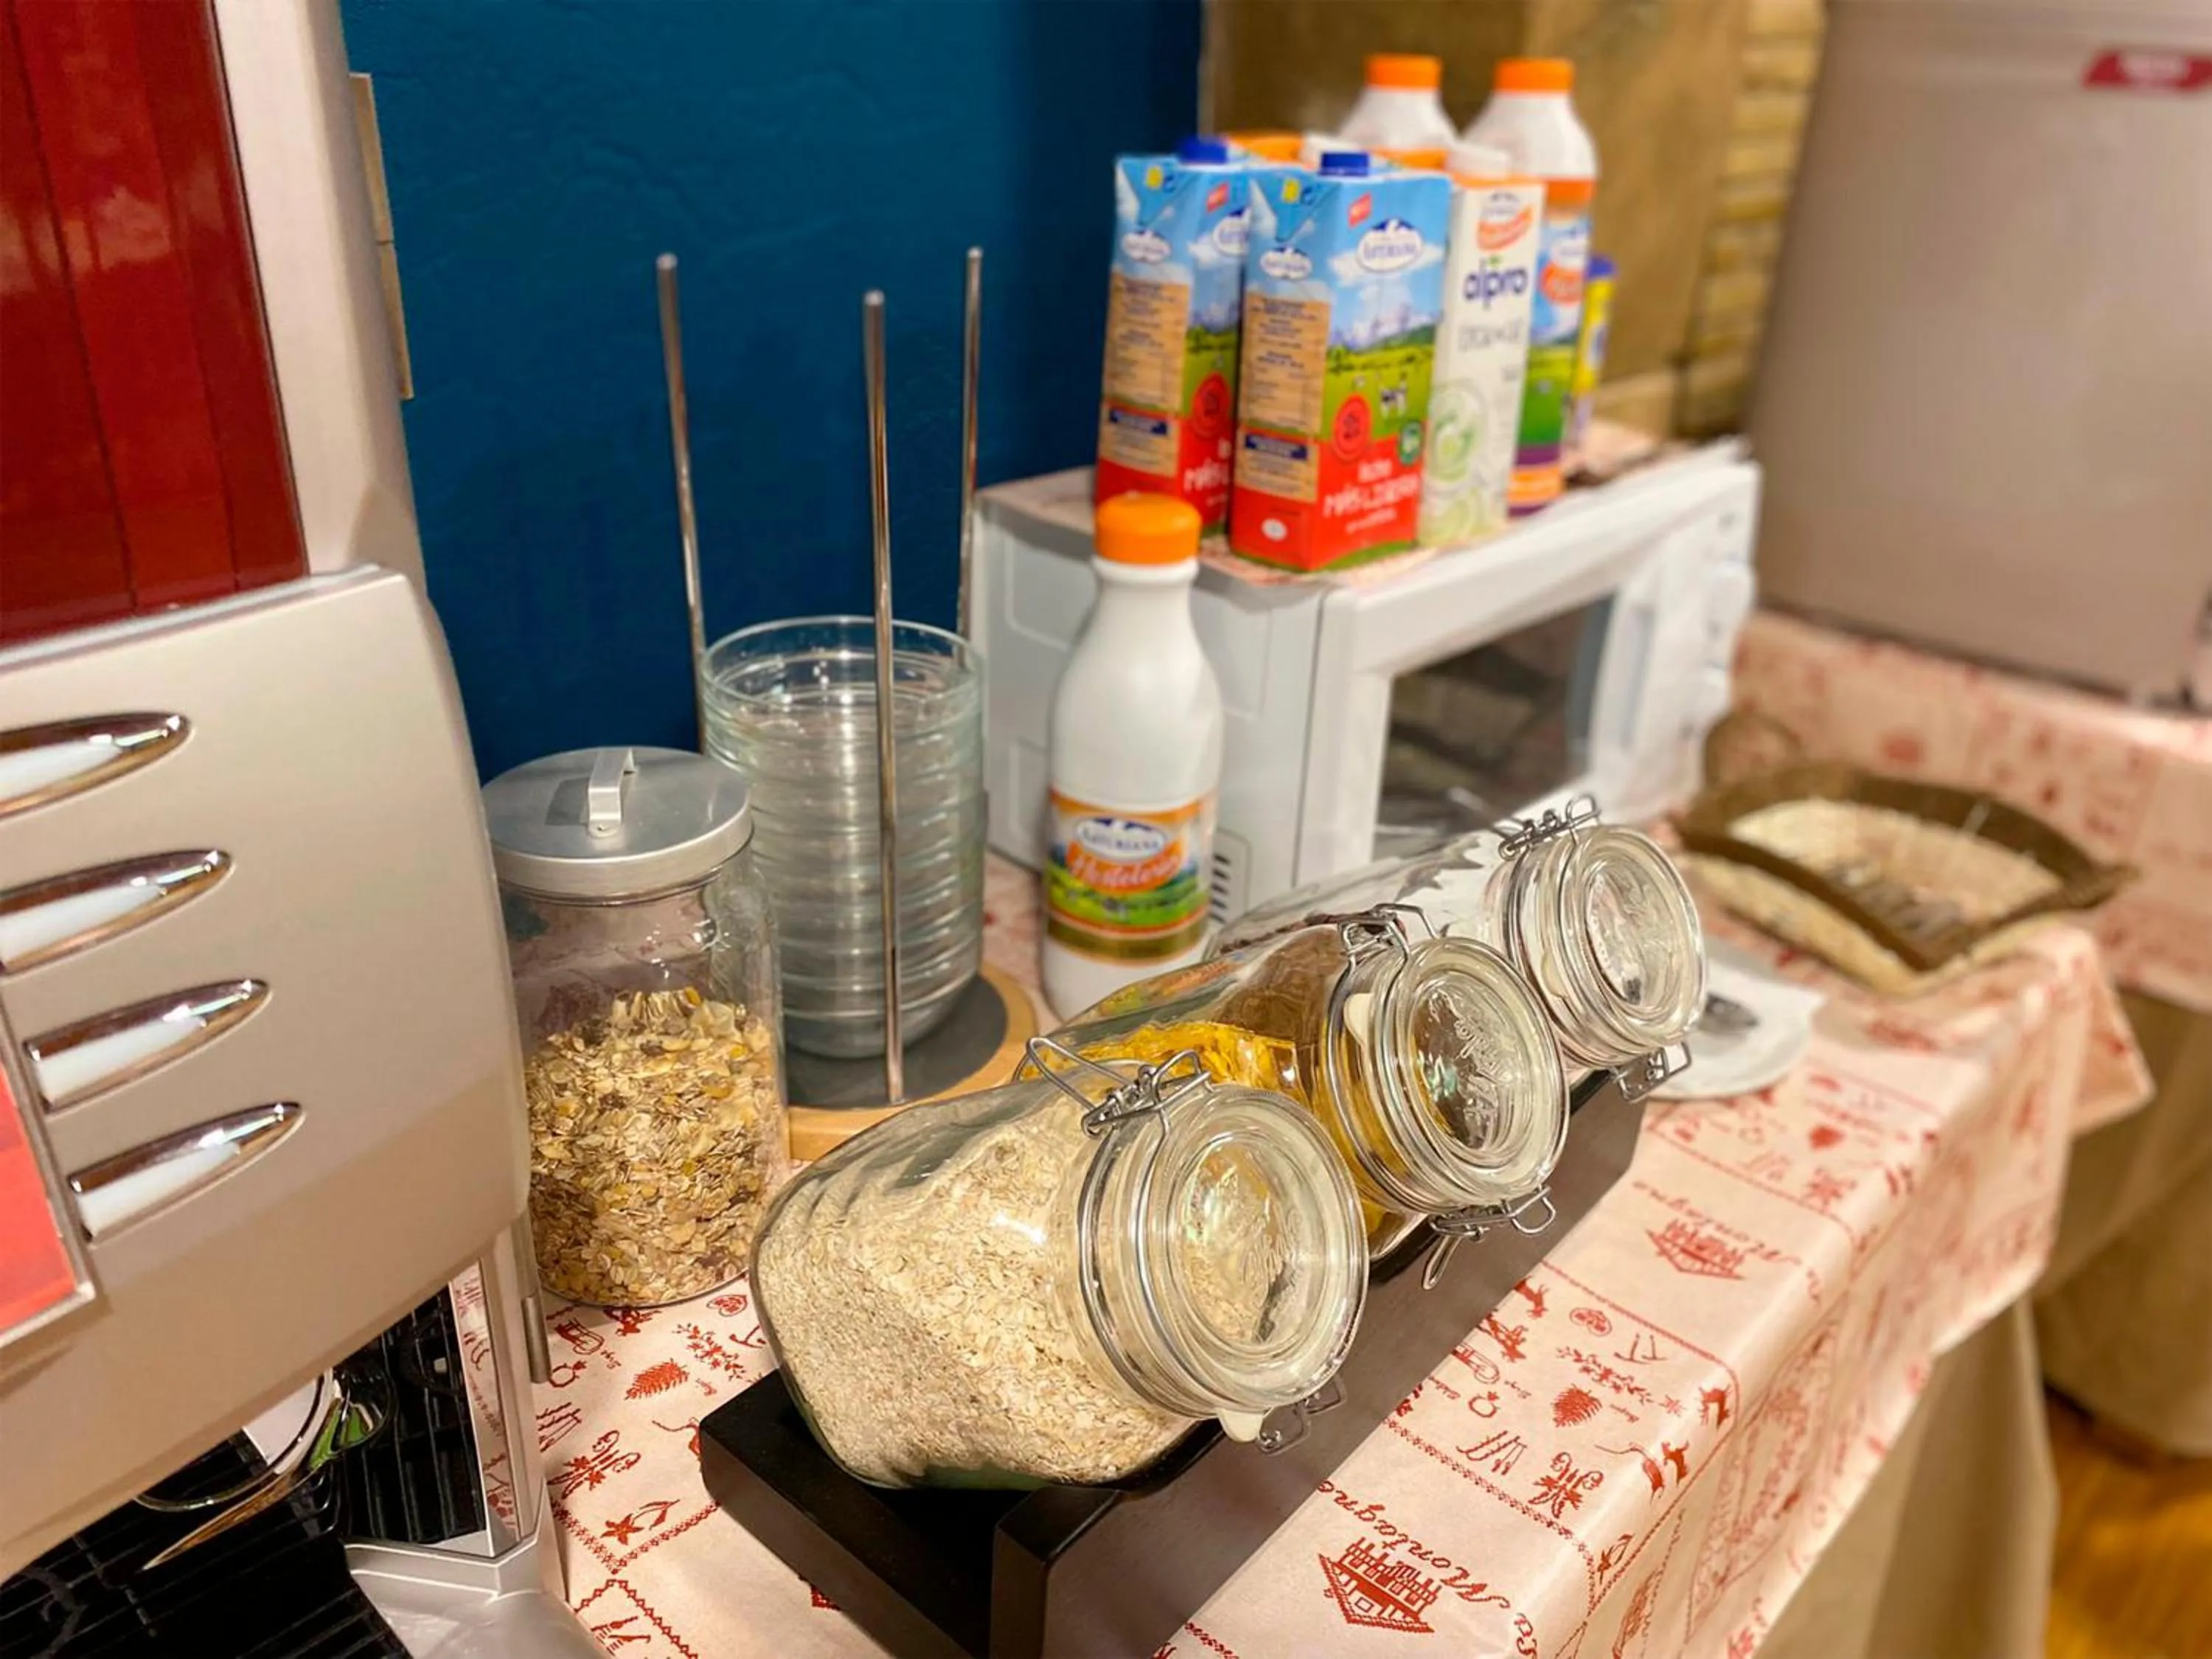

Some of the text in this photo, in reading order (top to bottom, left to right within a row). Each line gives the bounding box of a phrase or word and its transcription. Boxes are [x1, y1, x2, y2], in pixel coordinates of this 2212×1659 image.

[1463, 257, 1528, 310] alpro
[1632, 1181, 1802, 1266] Montagne
[1317, 1477, 1511, 1609] Montagne
